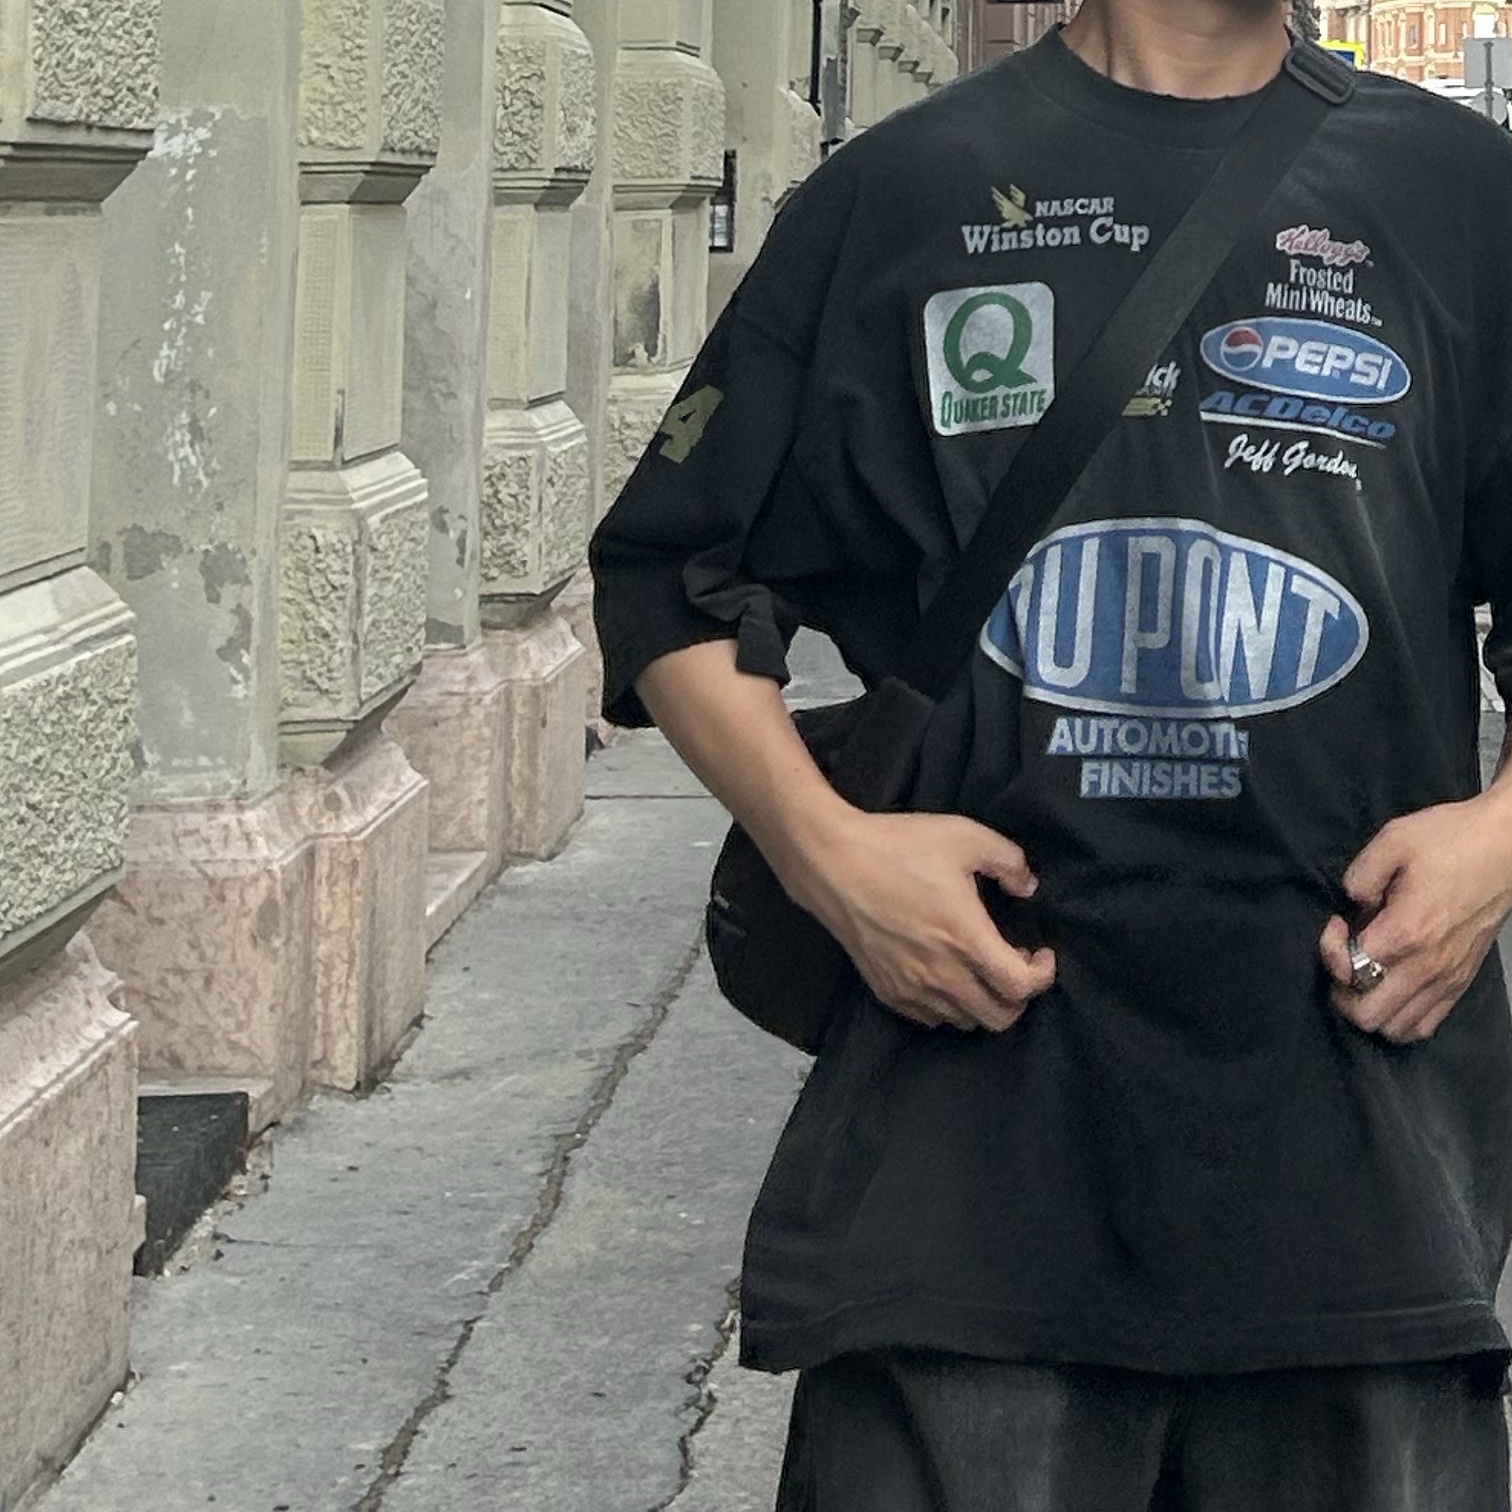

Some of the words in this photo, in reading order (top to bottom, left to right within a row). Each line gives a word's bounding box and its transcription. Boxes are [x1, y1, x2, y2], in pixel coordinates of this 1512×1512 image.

[1035, 196, 1115, 218] NASCAR
[961, 222, 1081, 255] Winston
[1089, 216, 1150, 253] Cup
[1289, 258, 1355, 295] Frosted
[1261, 335, 1394, 391] PEPSI
[1001, 388, 1048, 419] STATE
[1200, 391, 1396, 438] ACDelco
[1224, 433, 1281, 473] Jeff
[1080, 758, 1243, 800] FINISHES
